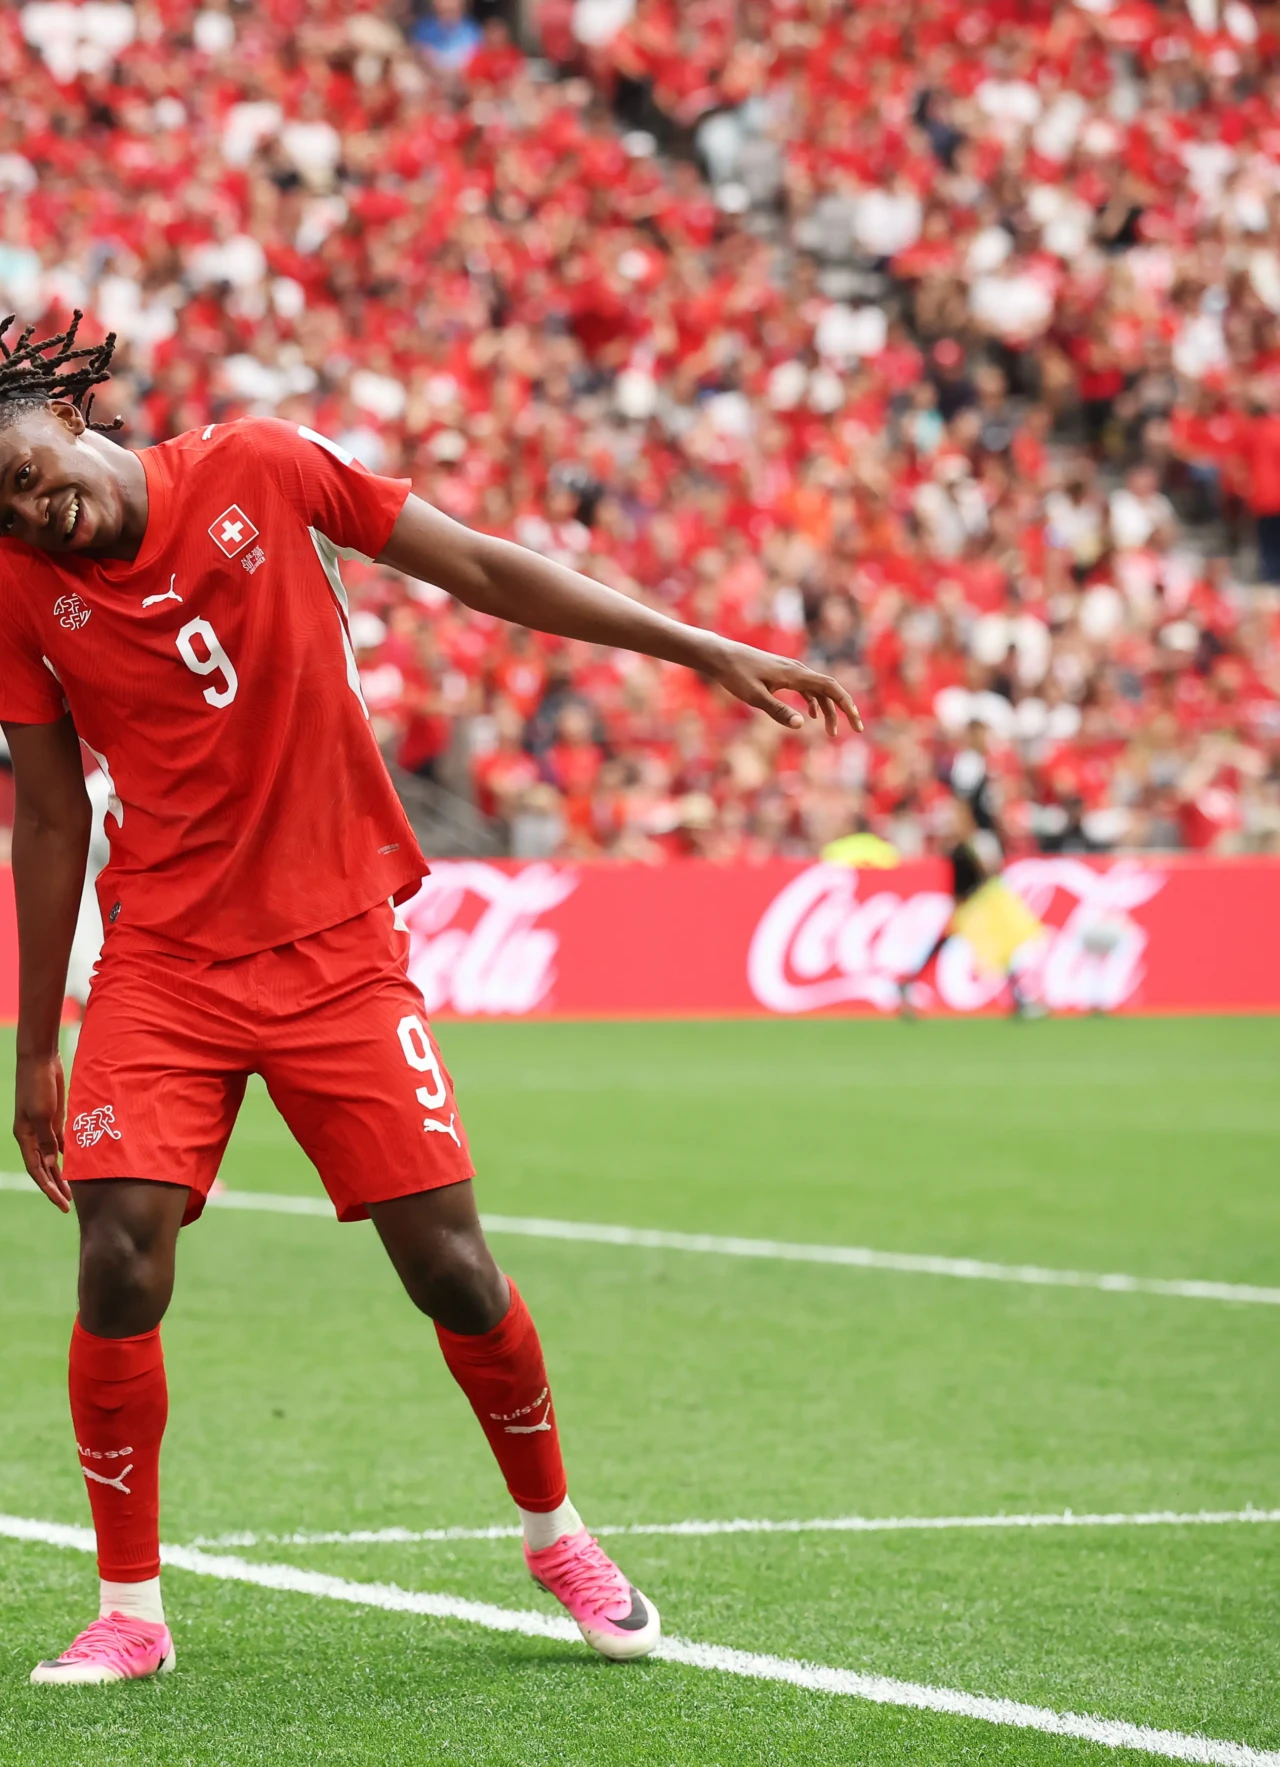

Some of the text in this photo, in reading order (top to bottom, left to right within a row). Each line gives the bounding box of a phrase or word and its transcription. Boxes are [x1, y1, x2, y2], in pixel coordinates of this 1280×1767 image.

[175, 615, 239, 709] 9
[747, 858, 1170, 1014] CocaCola
[396, 1014, 447, 1110] 9
